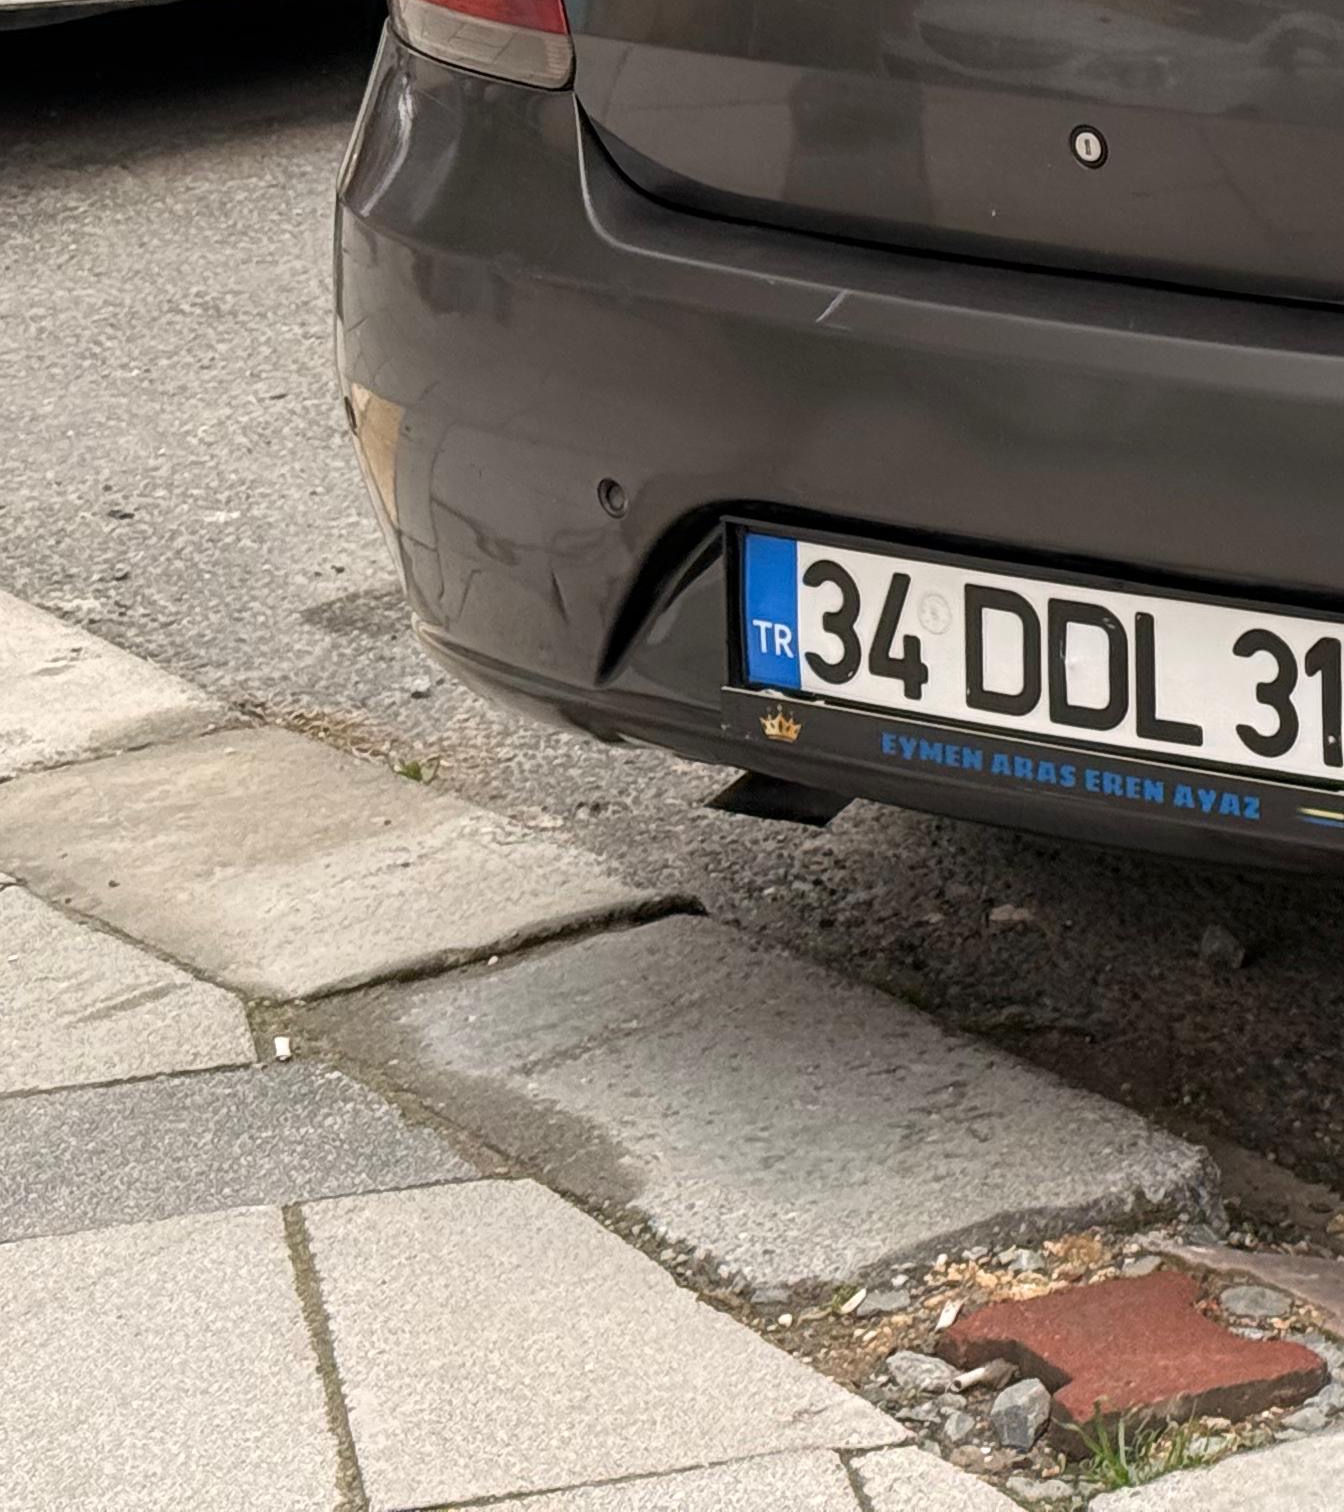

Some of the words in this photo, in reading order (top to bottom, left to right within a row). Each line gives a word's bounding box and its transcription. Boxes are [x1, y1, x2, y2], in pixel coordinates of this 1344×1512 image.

[752, 618, 794, 659] TR
[803, 559, 929, 700] 34
[963, 583, 1203, 747] DDL
[881, 732, 983, 771] EYMEN
[990, 752, 1077, 788] ARAS
[1084, 769, 1164, 804] EREN
[1172, 785, 1262, 820] AYAZ
